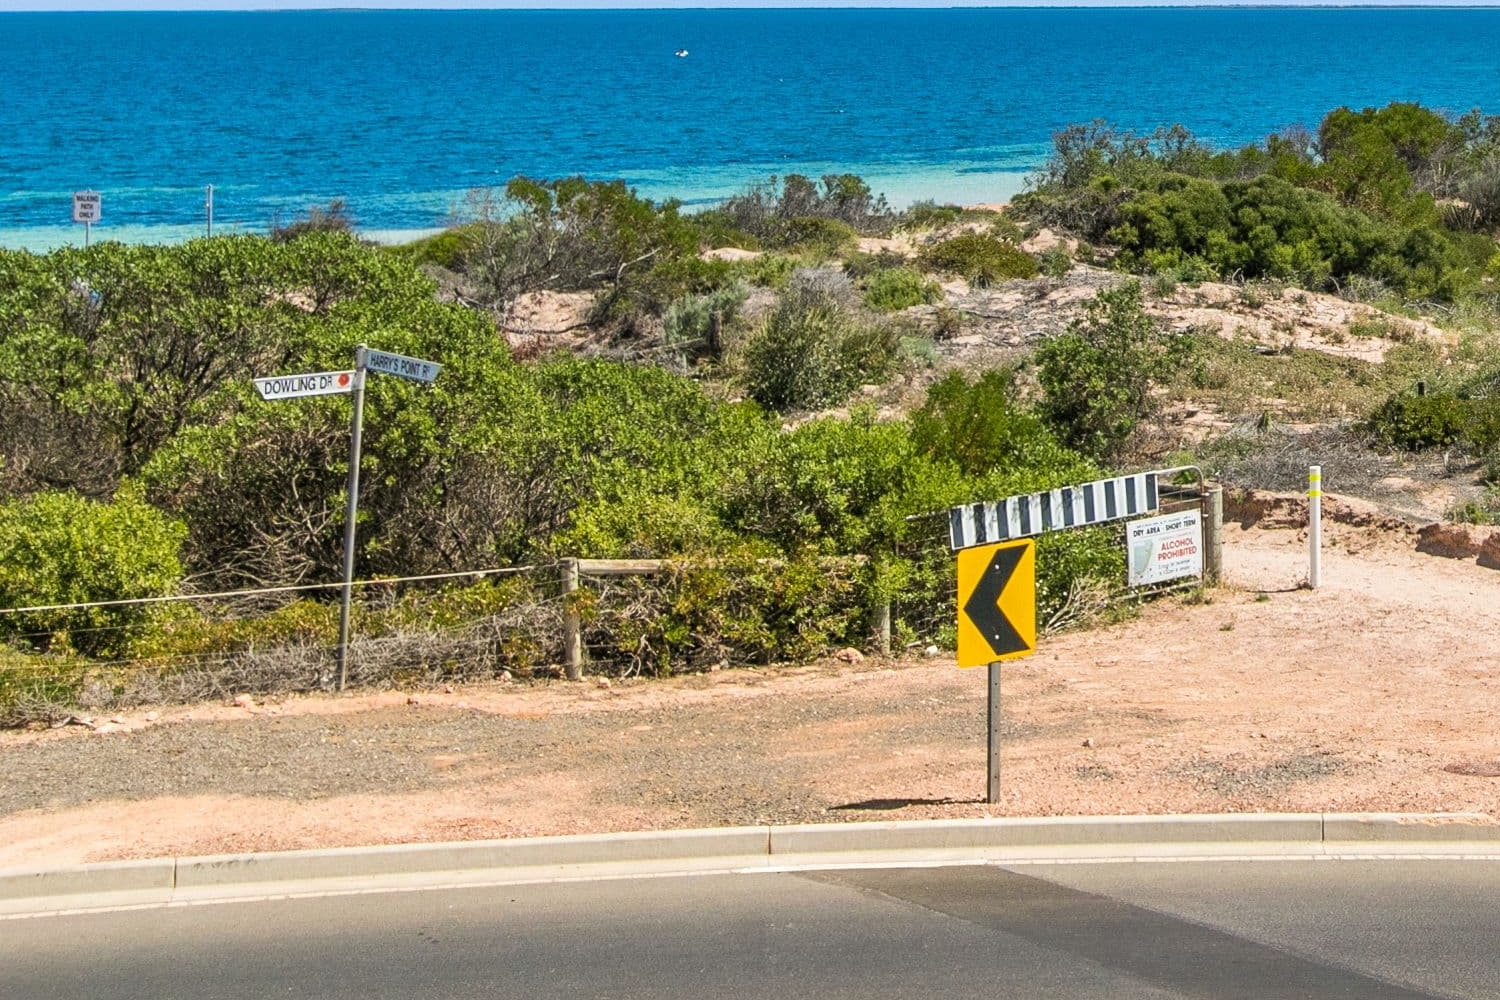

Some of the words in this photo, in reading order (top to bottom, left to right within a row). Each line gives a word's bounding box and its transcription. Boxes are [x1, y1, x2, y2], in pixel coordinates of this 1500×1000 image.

[370, 353, 399, 371] HARRY'S
[400, 360, 420, 375] POINT
[264, 378, 316, 395] DOWLING
[319, 375, 333, 389] DR
[1133, 529, 1145, 538] DRY
[1146, 526, 1161, 535] AREA
[1165, 521, 1182, 531] SHORT
[1183, 518, 1197, 527] TERM
[1157, 545, 1198, 561] PROHIBITED
[1161, 537, 1194, 551] ALCOHOL
